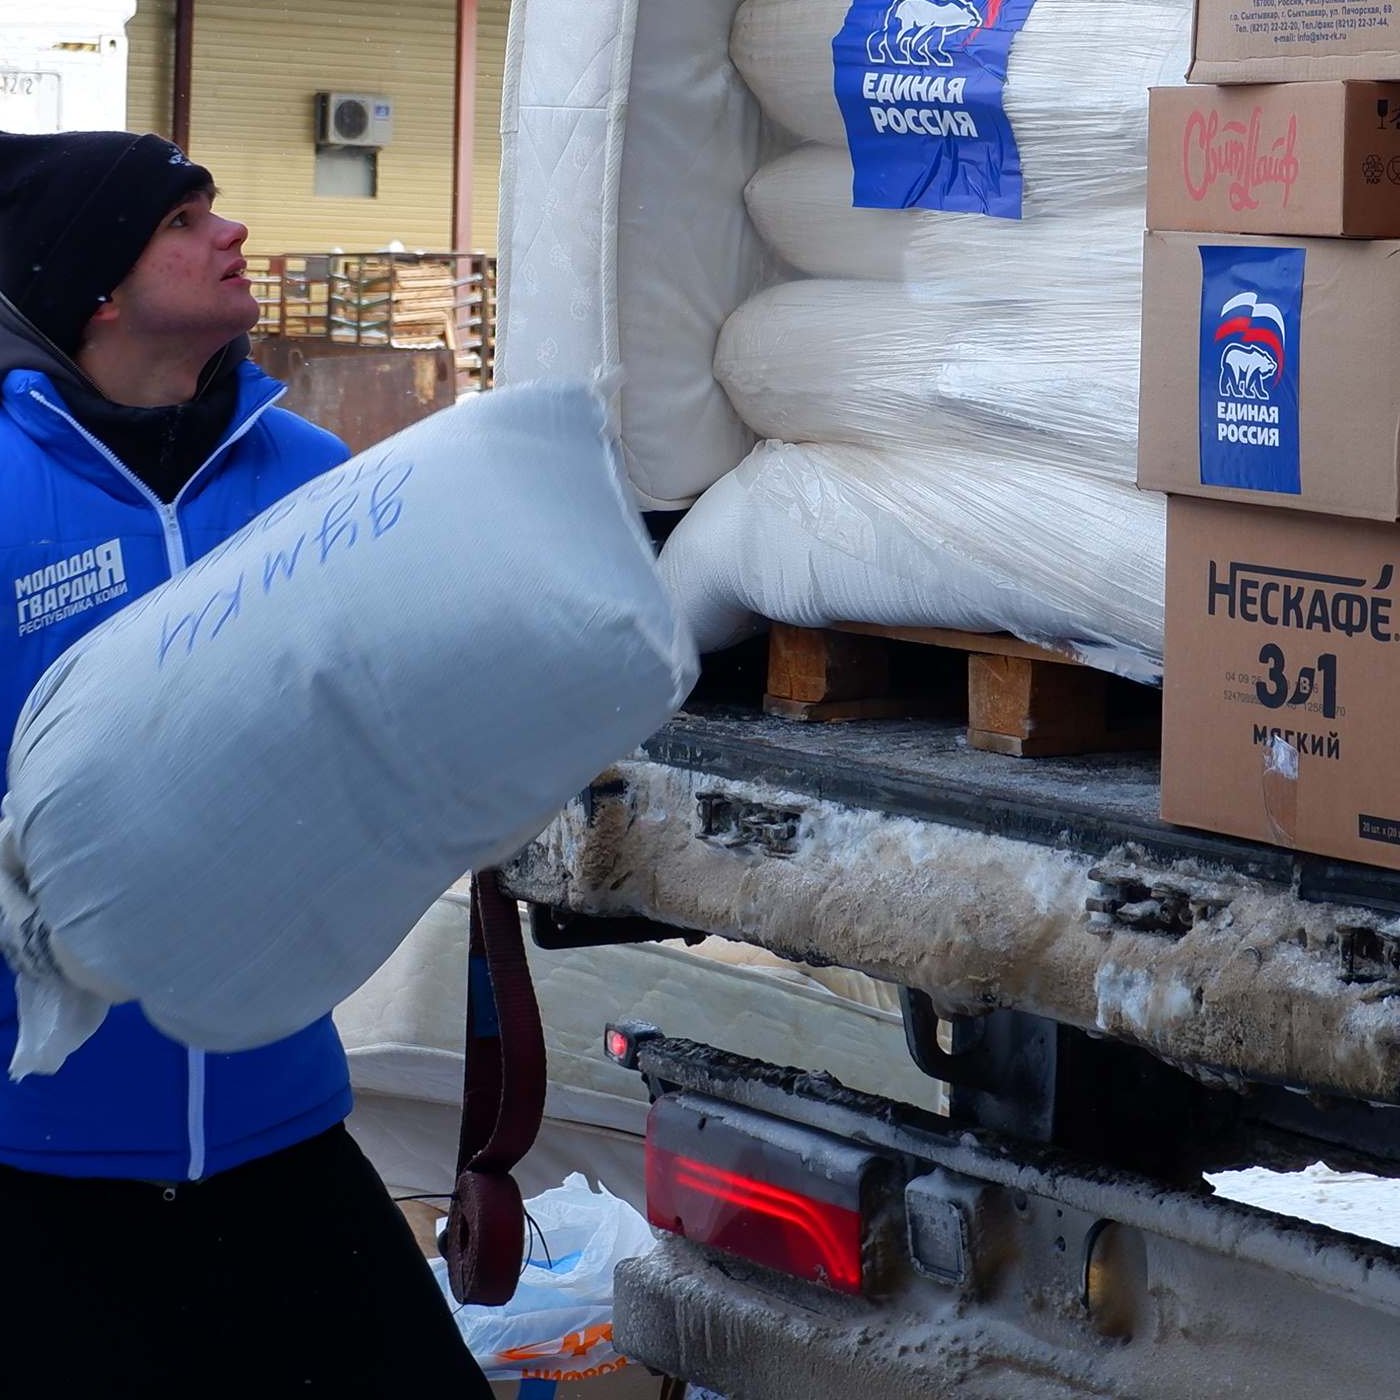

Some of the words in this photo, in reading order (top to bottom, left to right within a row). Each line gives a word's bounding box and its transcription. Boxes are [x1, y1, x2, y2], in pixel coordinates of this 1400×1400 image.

[862, 72, 966, 105] ЕДИНАЯ
[869, 106, 979, 138] РОССИЯ
[1216, 401, 1279, 425] ЕДИНАЯ
[1217, 423, 1280, 448] РОССИЯ
[15, 538, 125, 599] МОЛОДАЯ
[19, 597, 94, 637] РЕСПУБЛИКА
[95, 581, 128, 605] КОМИ
